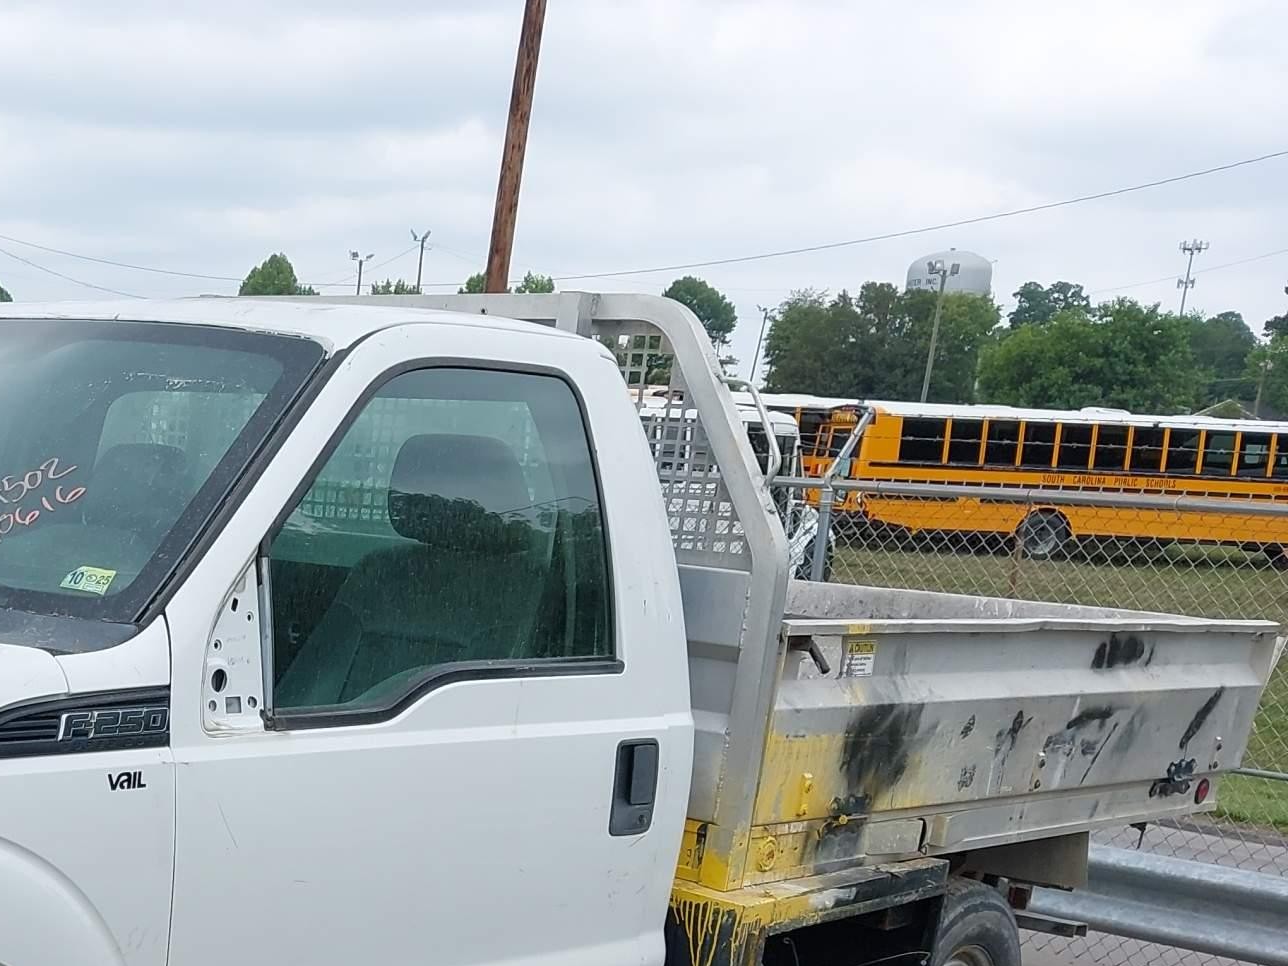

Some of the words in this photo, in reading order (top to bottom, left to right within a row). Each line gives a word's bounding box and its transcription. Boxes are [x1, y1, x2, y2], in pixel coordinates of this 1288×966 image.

[1041, 474, 1065, 484] SOUTH
[1072, 475, 1106, 486] CAROLINA
[1113, 477, 1138, 487] PUBLIC
[1145, 478, 1177, 489] SCHOOLS
[68, 571, 85, 585] 10
[96, 575, 112, 586] 25
[57, 706, 170, 742] F-250
